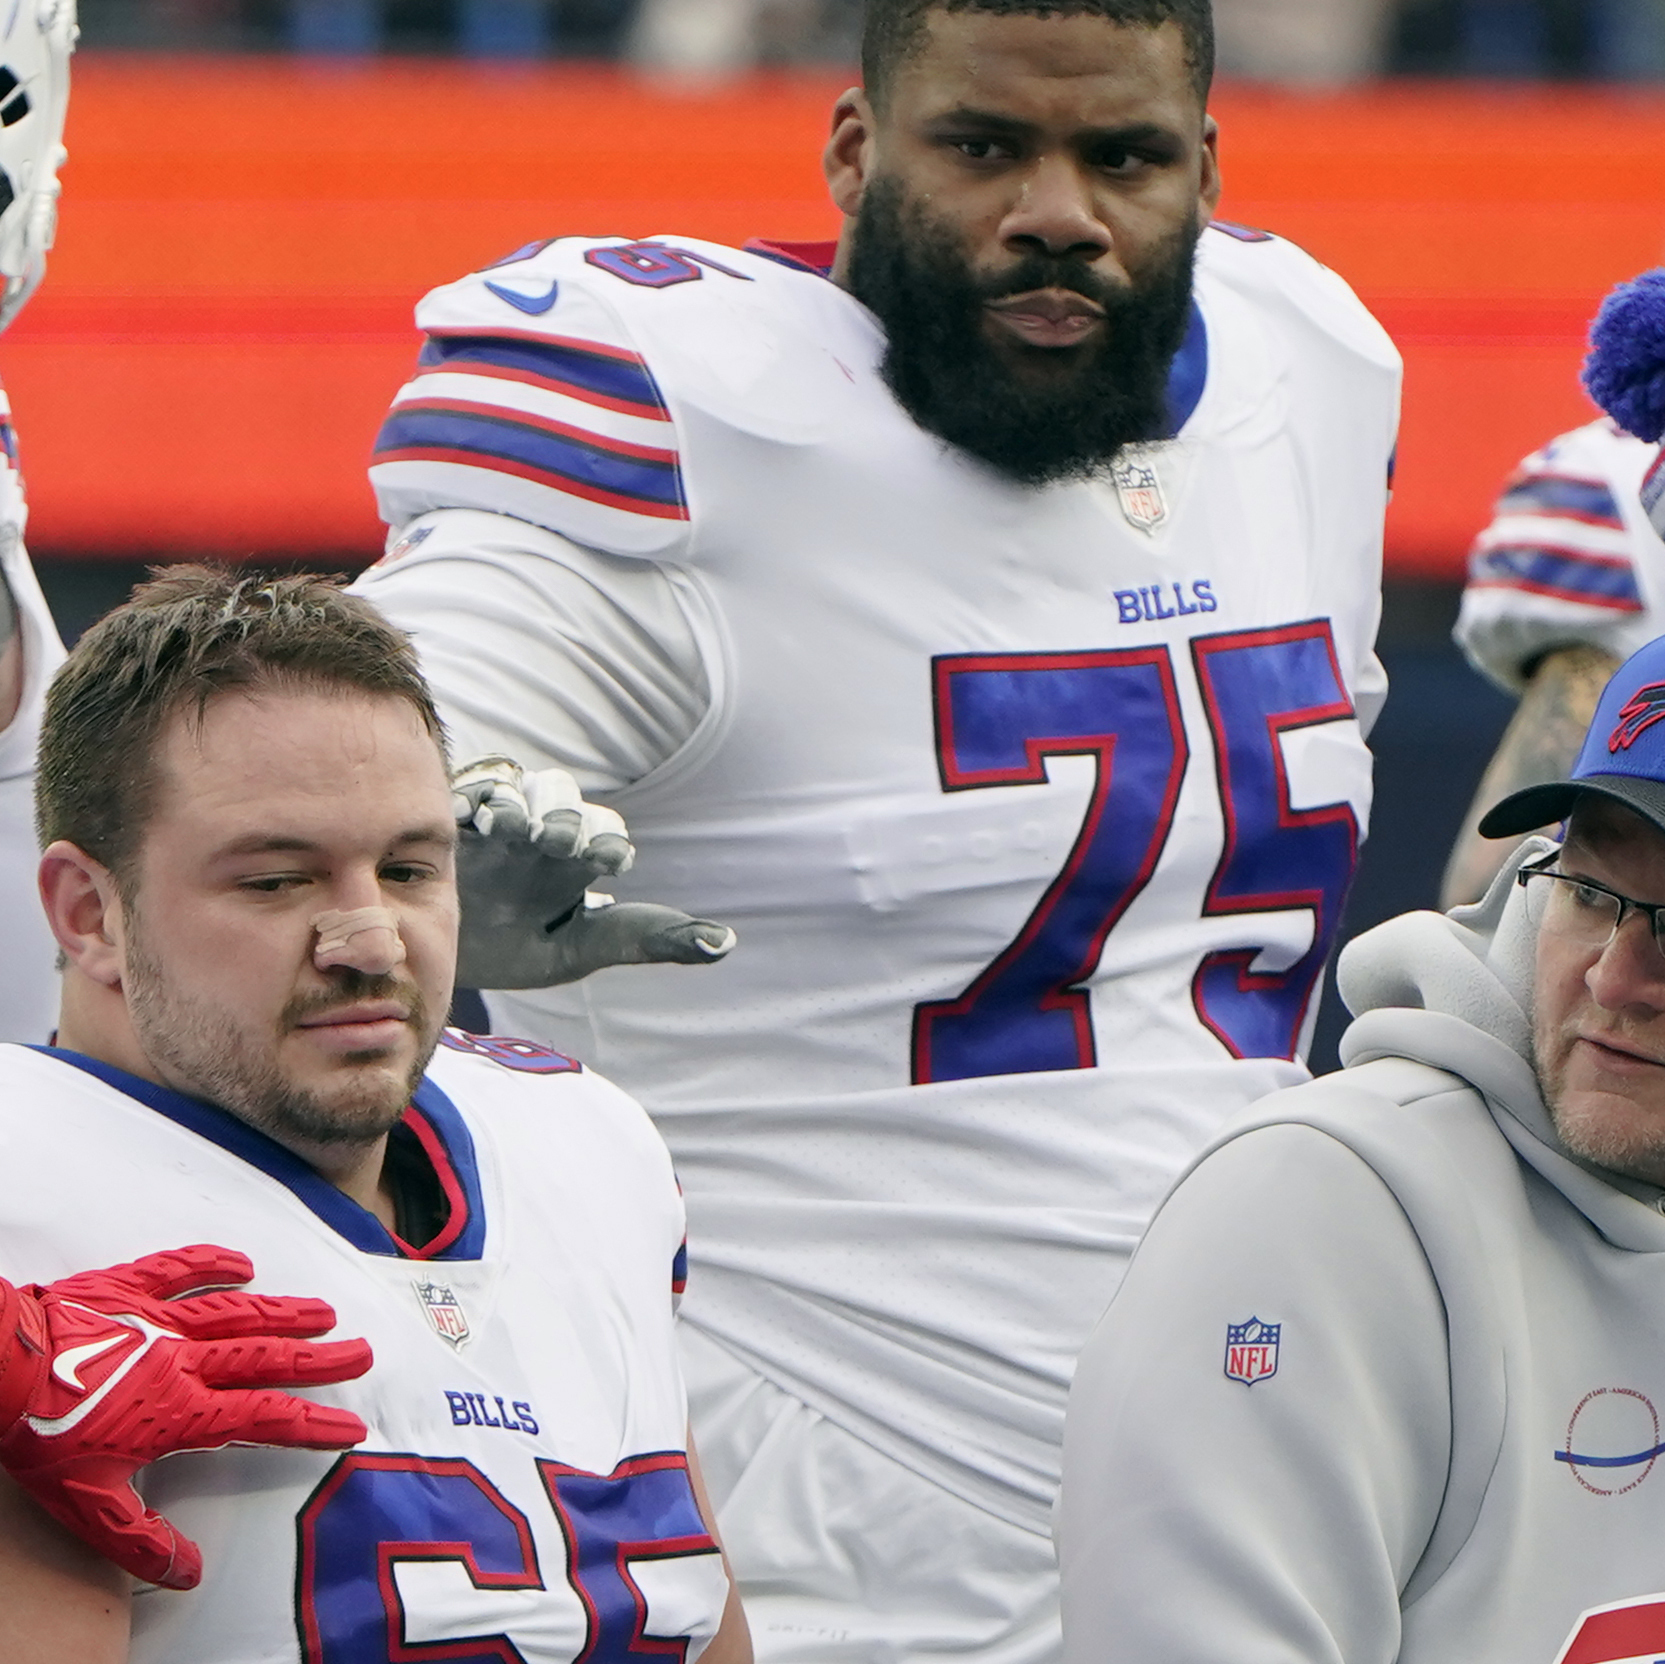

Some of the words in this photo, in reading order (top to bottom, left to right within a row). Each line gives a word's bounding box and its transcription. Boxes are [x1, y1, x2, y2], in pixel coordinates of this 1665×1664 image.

[1128, 490, 1161, 520] NFL
[1113, 579, 1218, 624] BILLS
[910, 617, 1361, 1086] 75
[430, 1307, 466, 1336] NFL
[1229, 1347, 1273, 1379] NFL
[444, 1391, 540, 1436] BILLS
